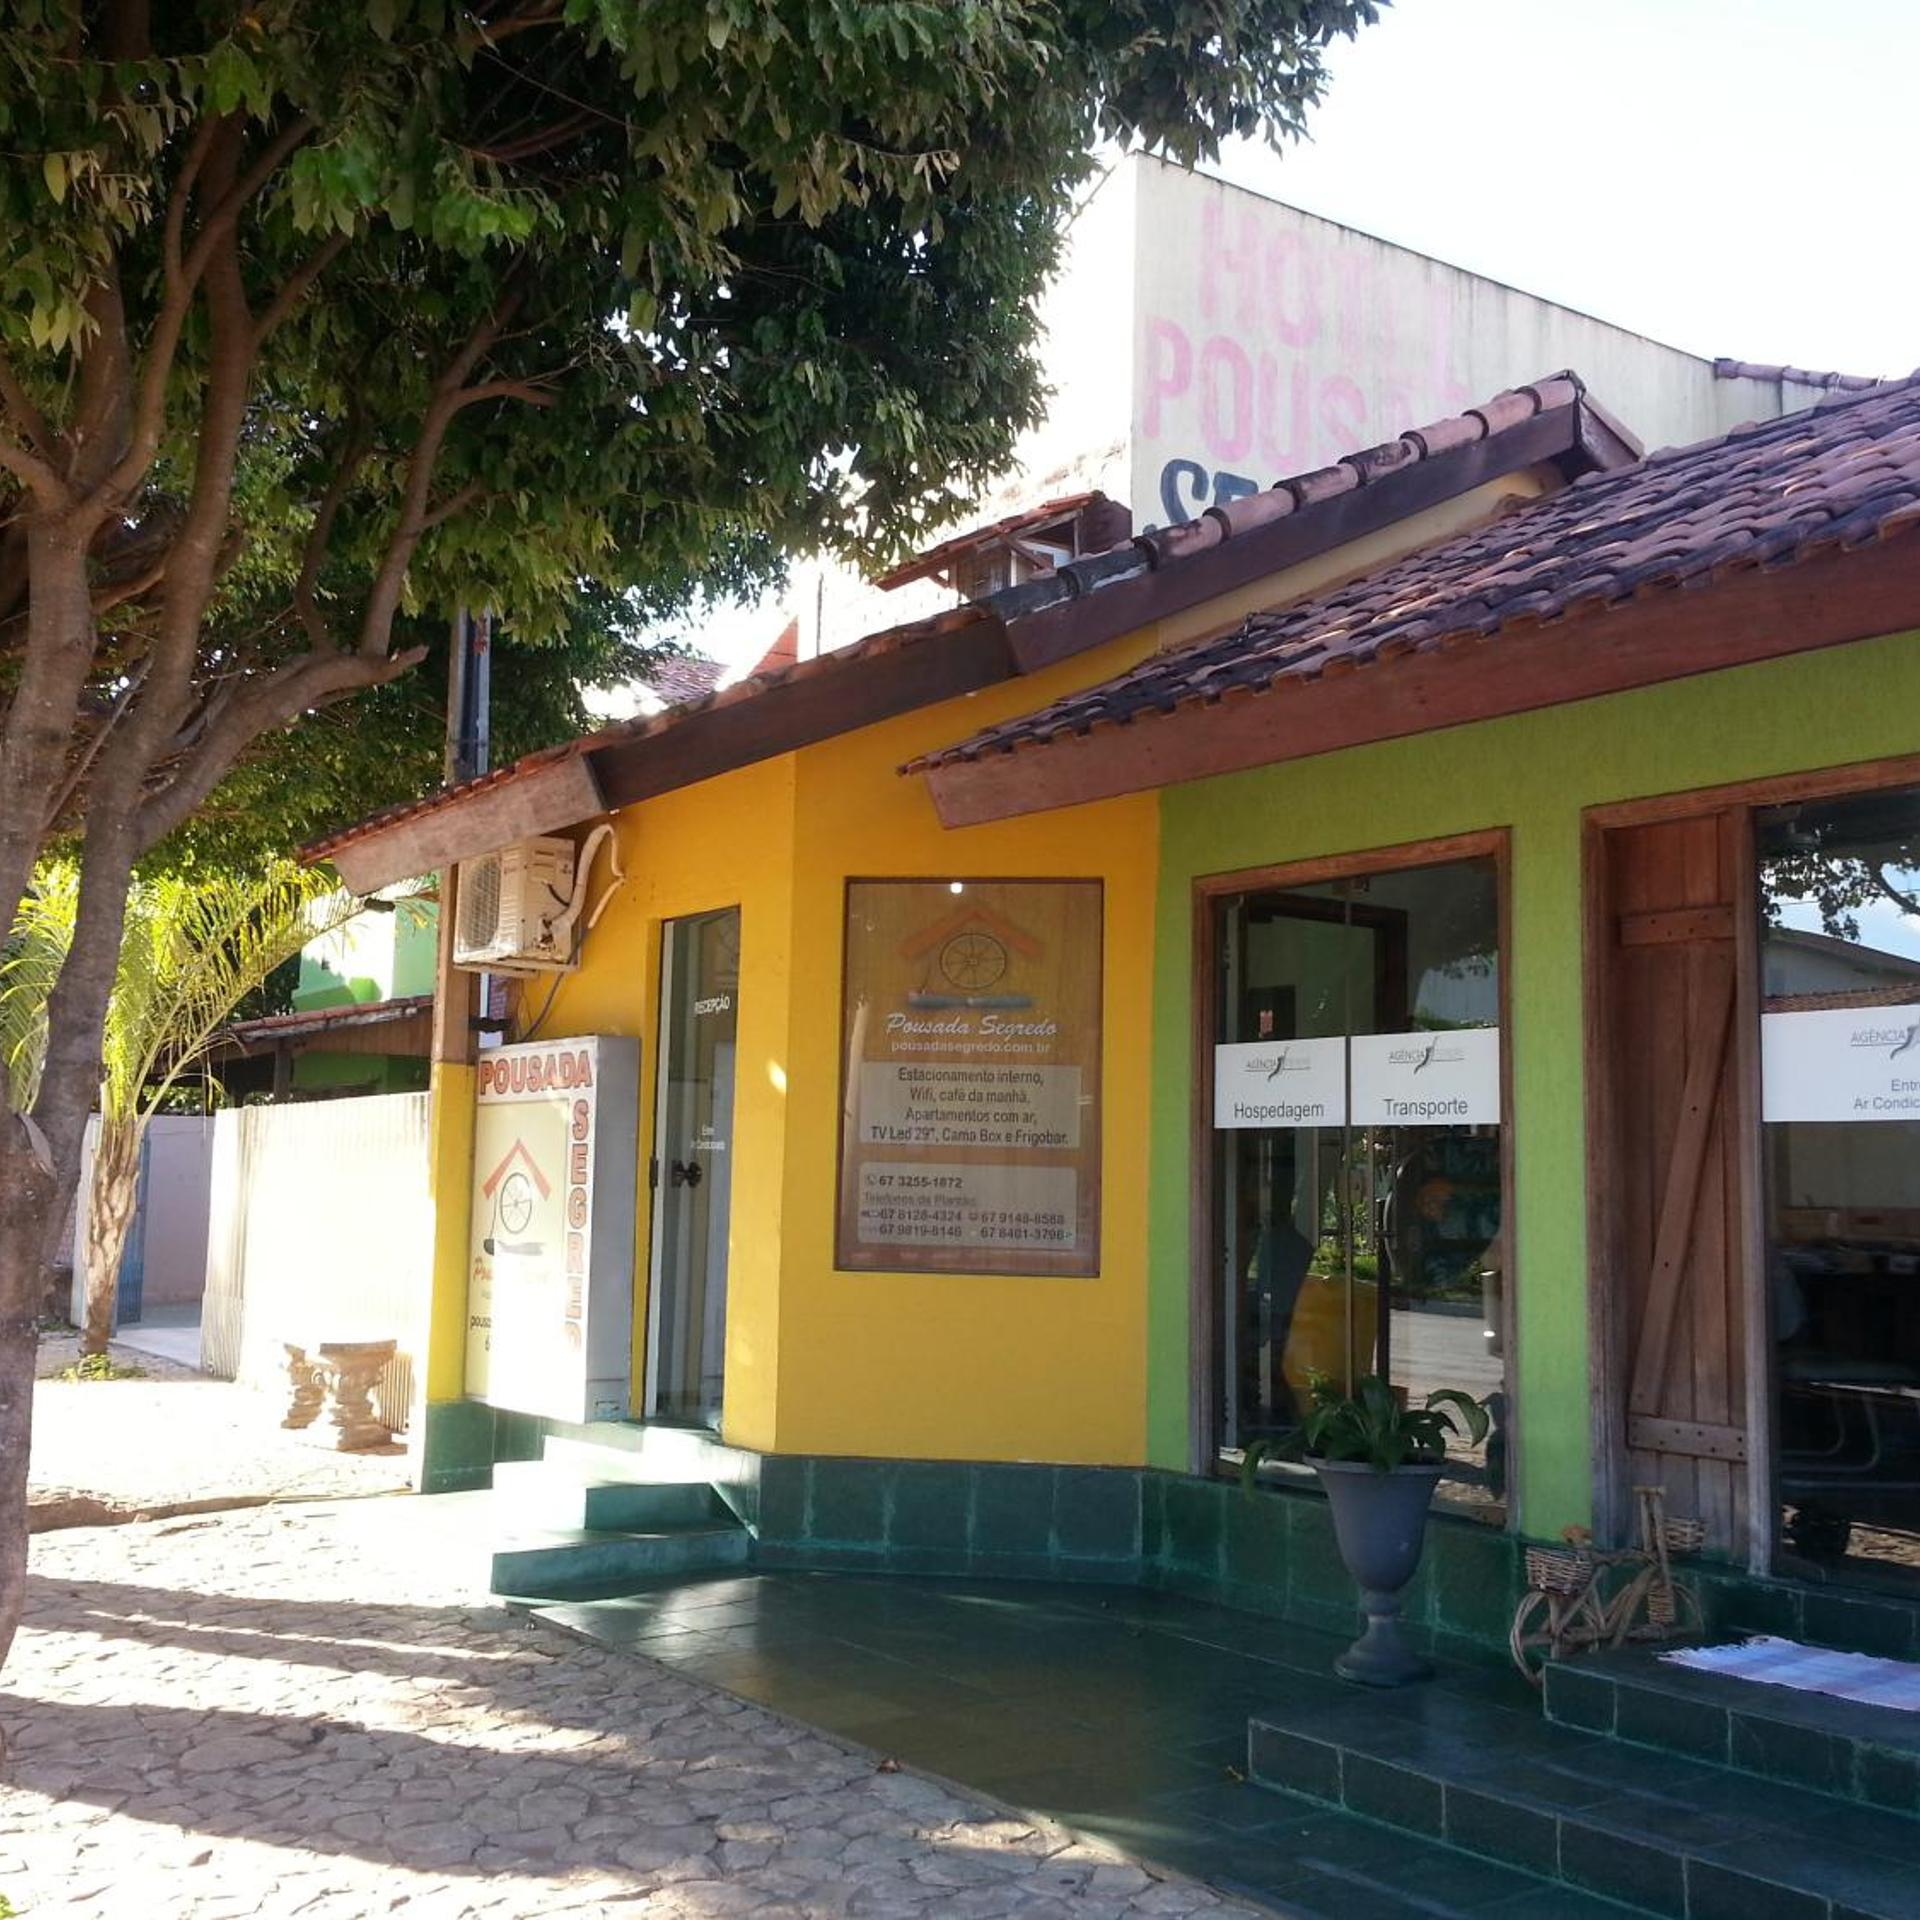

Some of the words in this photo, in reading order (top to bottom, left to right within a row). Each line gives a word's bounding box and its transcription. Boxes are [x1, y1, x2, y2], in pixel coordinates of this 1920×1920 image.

[886, 1013, 970, 1036] Pousada
[979, 1015, 1057, 1042] Segredo
[891, 1040, 1051, 1054] pousadasegredo.com.br
[480, 1050, 592, 1096] POUSADA
[898, 1067, 995, 1083] Estacionamento
[998, 1069, 1044, 1086] interno,
[939, 1087, 964, 1101] café
[968, 1089, 983, 1101] da
[1891, 1079, 1920, 1091] Entr
[1233, 1102, 1324, 1122] Hospedagem
[1384, 1098, 1468, 1118] Transporte
[1853, 1098, 1869, 1110] Ar
[904, 1107, 990, 1126] Apartamentos
[993, 1112, 1016, 1124] com
[1018, 1113, 1037, 1126] ar,
[871, 1126, 888, 1140] TV
[889, 1126, 911, 1141] Led
[942, 1129, 976, 1143] Cama
[980, 1130, 1000, 1143] Box
[1005, 1133, 1012, 1143] e
[1015, 1130, 1069, 1147] Frigobar.
[879, 1176, 894, 1187] 67
